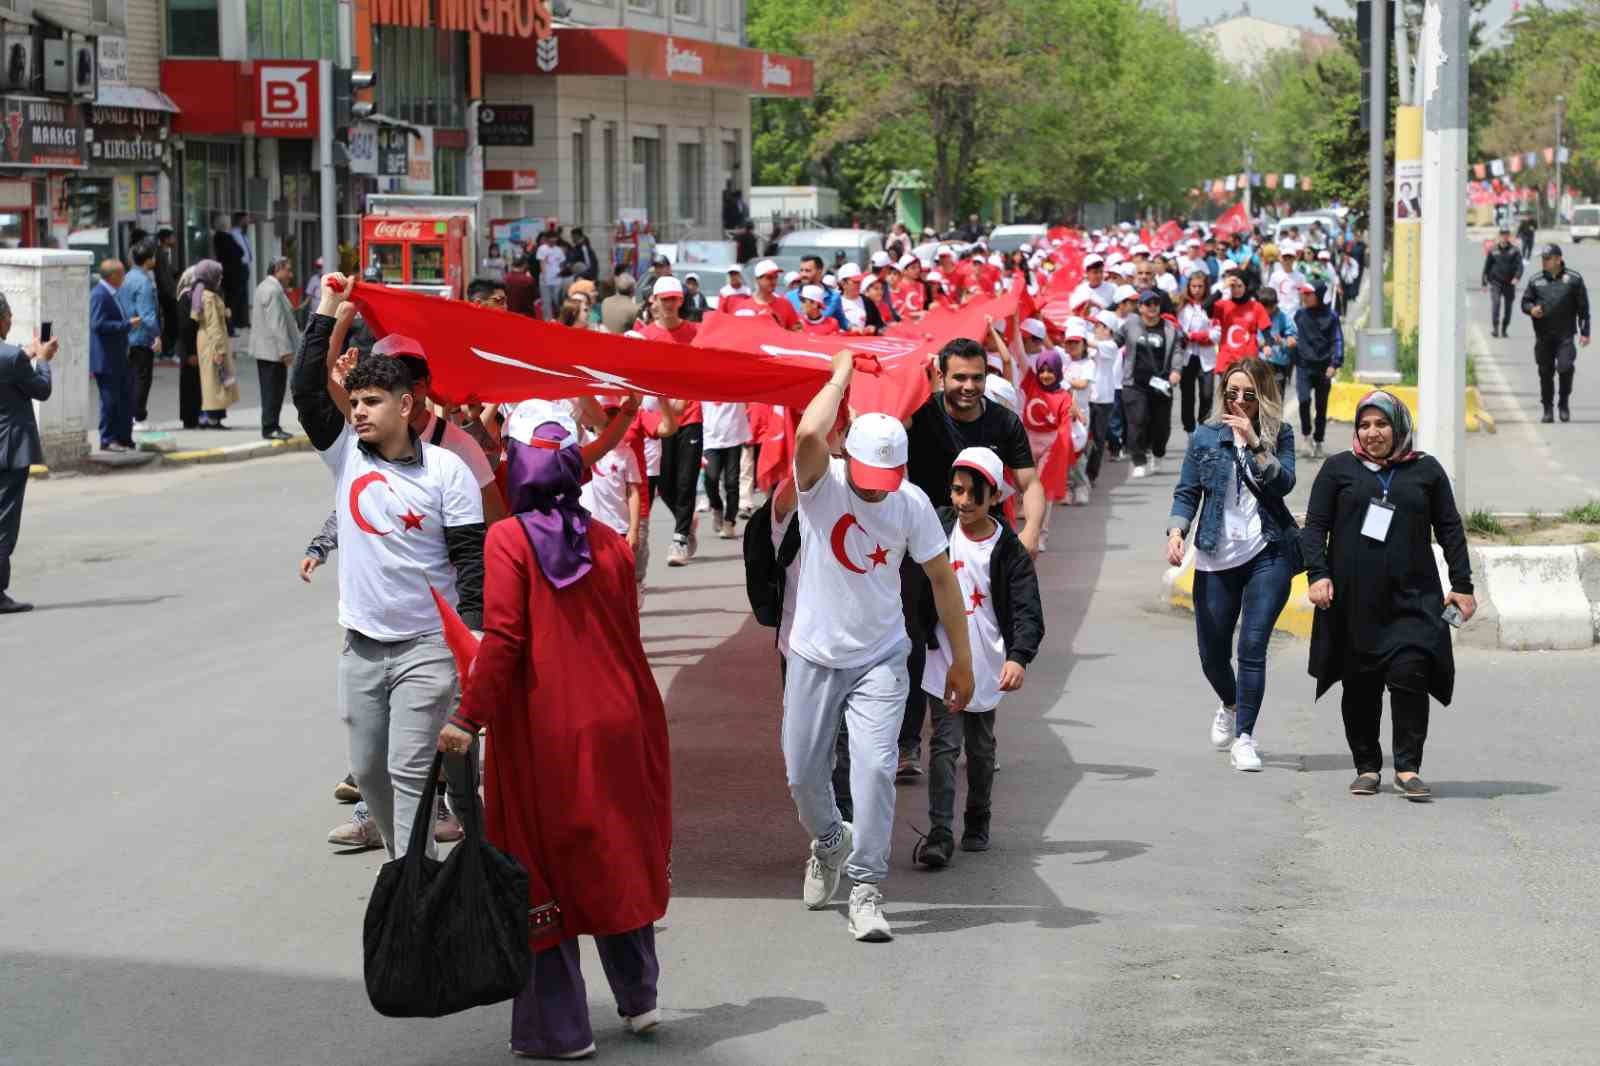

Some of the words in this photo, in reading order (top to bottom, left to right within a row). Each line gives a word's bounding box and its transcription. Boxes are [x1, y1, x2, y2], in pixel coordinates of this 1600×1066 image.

[439, 0, 552, 39] MIGROS
[31, 125, 77, 147] MARKET
[374, 221, 423, 239] Coca-Cola
